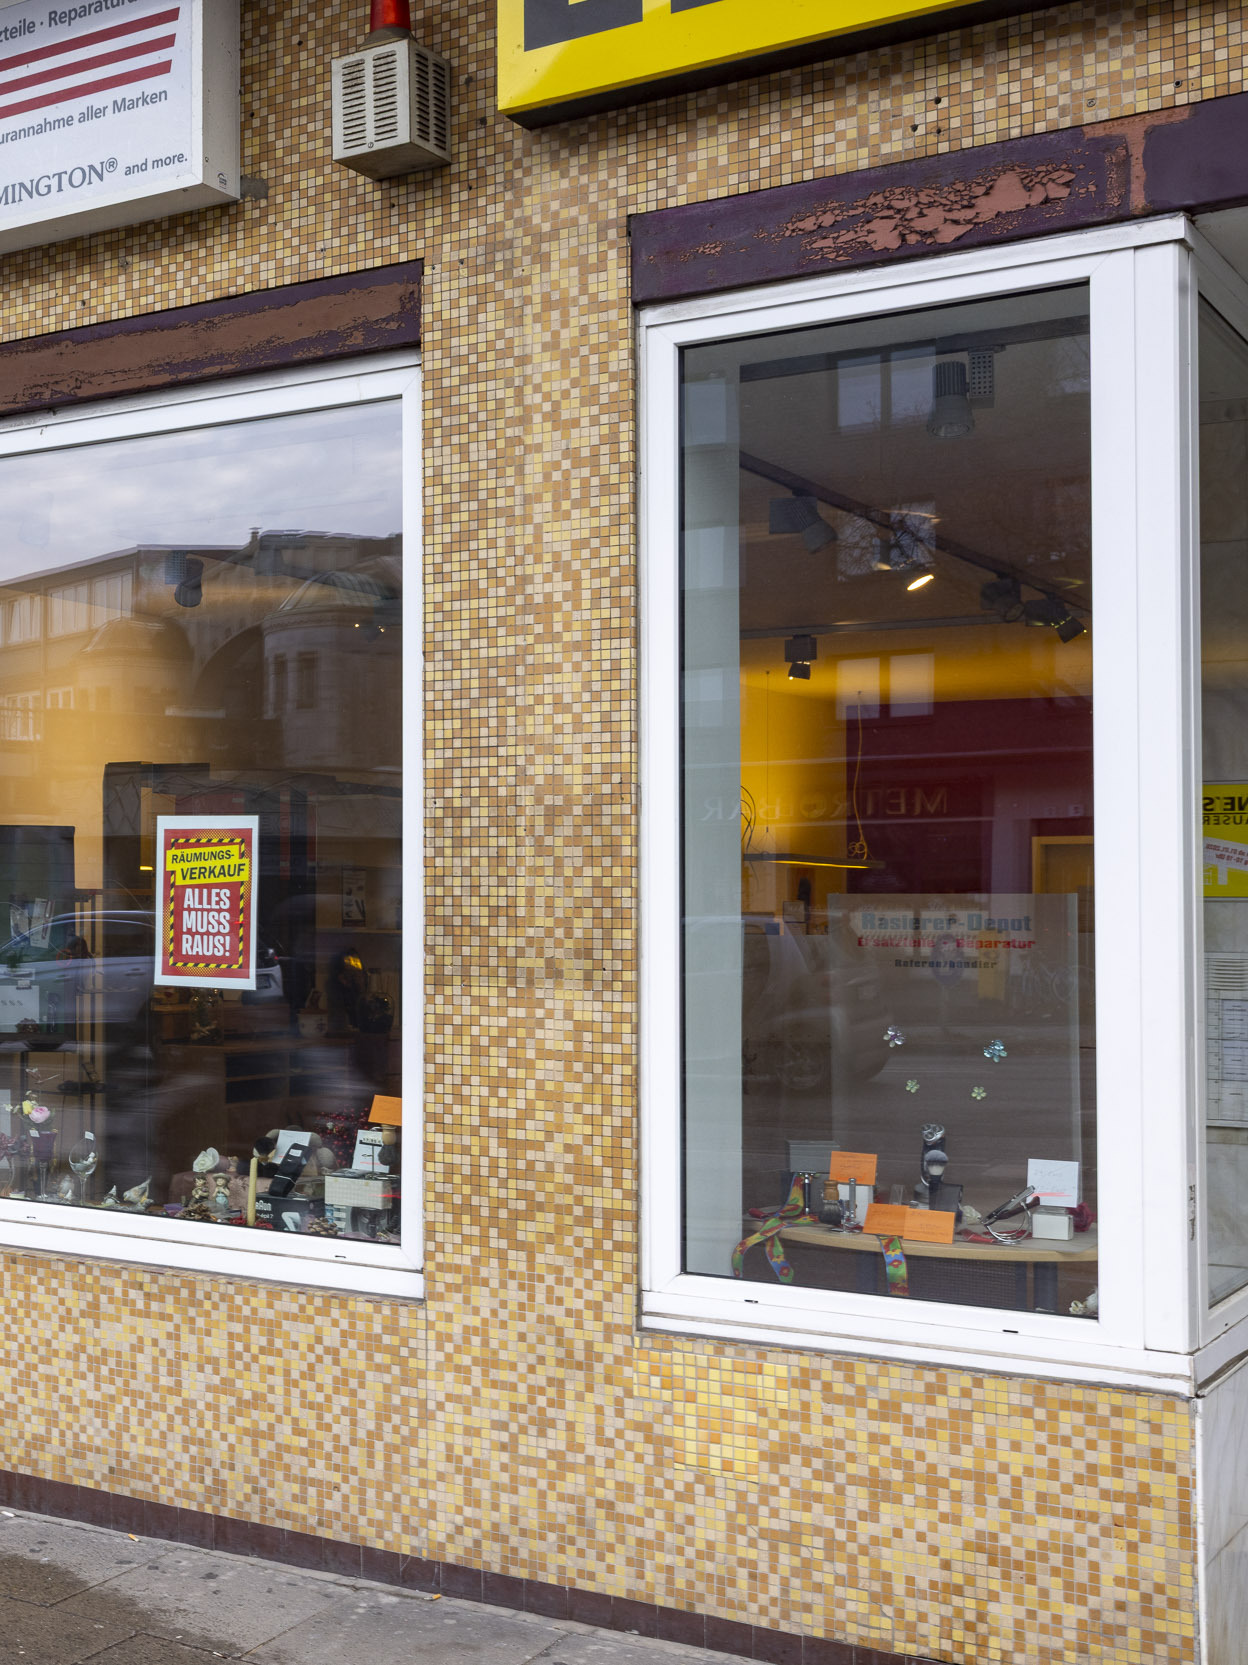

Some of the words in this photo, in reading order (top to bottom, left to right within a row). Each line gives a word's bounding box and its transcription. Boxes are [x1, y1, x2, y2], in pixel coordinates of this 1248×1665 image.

[77, 103, 109, 124] aller
[111, 89, 168, 115] Marken
[124, 158, 148, 176] and
[151, 152, 188, 172] more.
[171, 849, 235, 865] RÄUMUNGS-
[180, 863, 246, 880] VERKAUF
[183, 888, 230, 910] ALLES
[182, 911, 230, 933] MUSS
[860, 912, 1033, 935] Rasierer-Depot
[181, 934, 230, 957] RAUS!
[857, 937, 936, 949] Ersatzteile
[956, 938, 1037, 951] Reparatur
